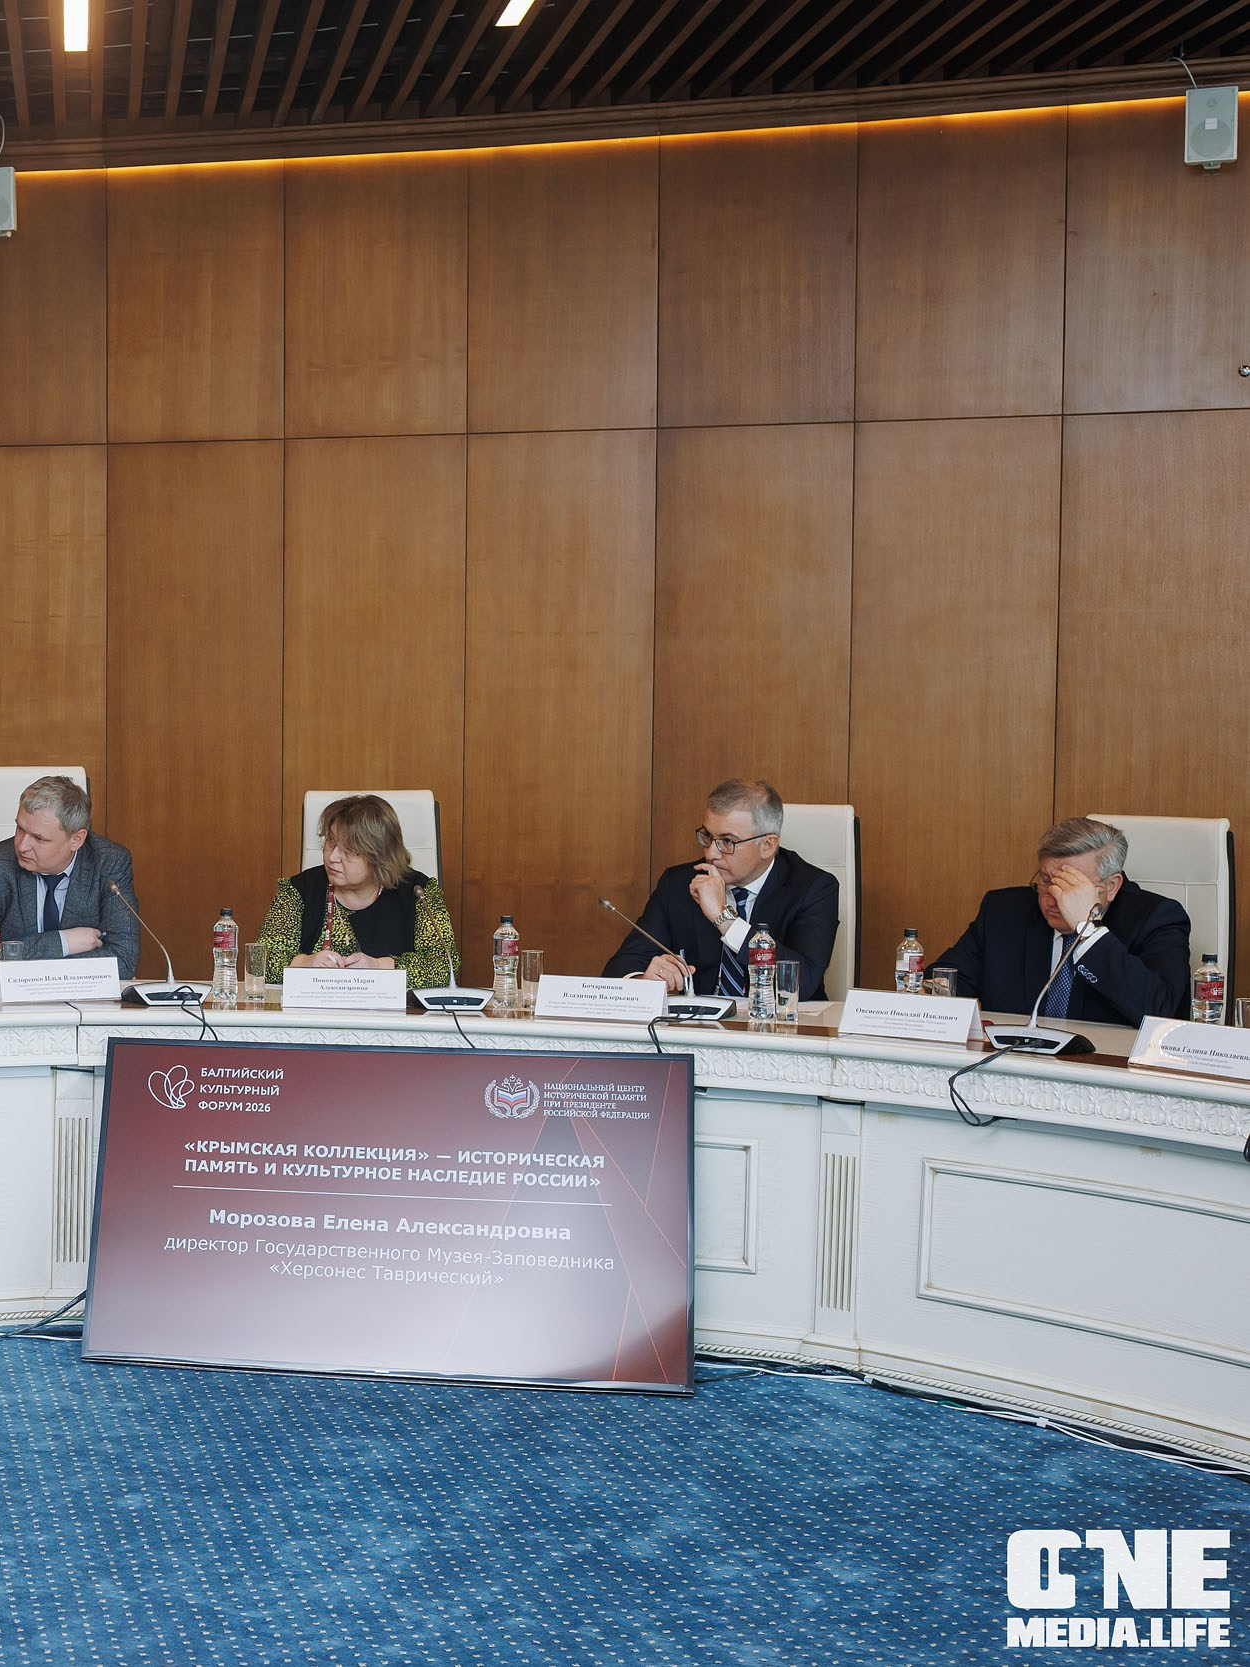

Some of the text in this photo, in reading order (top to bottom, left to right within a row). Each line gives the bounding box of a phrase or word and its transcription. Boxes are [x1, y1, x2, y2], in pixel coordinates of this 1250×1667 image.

[562, 992, 639, 1002] Владимир Валерьевич
[1182, 1046, 1208, 1056] Галина
[200, 1068, 284, 1080] БАЛТИЙСКИЙ
[200, 1084, 280, 1096] КУЛЬТУРНЫЙ
[544, 1082, 645, 1093] НАЦИОНАЛЬНЫЙ ЦЕНТР
[544, 1092, 647, 1102] ИСТОРИЧЕСКОЙ ПАМЯТИ
[198, 1100, 271, 1112] ФОРУМ 2026
[544, 1100, 617, 1110] ПРИ ПРЕЗИДЕНТЕ
[543, 1109, 650, 1120] РОССИЙСКОЙ ФЕДЕРАЦИИ
[184, 1140, 298, 1156] «КРЫМСКАЯ
[303, 1145, 430, 1162] КОЛЛЕКЦИЯ»
[458, 1150, 605, 1168] ИСТОРИЧЕСКАЯ
[184, 1159, 600, 1188] ПАМЯТЬ И КУЛЬТУРНОЕ НАСЛЕДИЕ РОССИИ»
[209, 1209, 571, 1241] Морозова Елена Александровна
[164, 1236, 614, 1270] директор Государственного Музея-Заповедника
[269, 1260, 504, 1285] «Херсонес Таврический»
